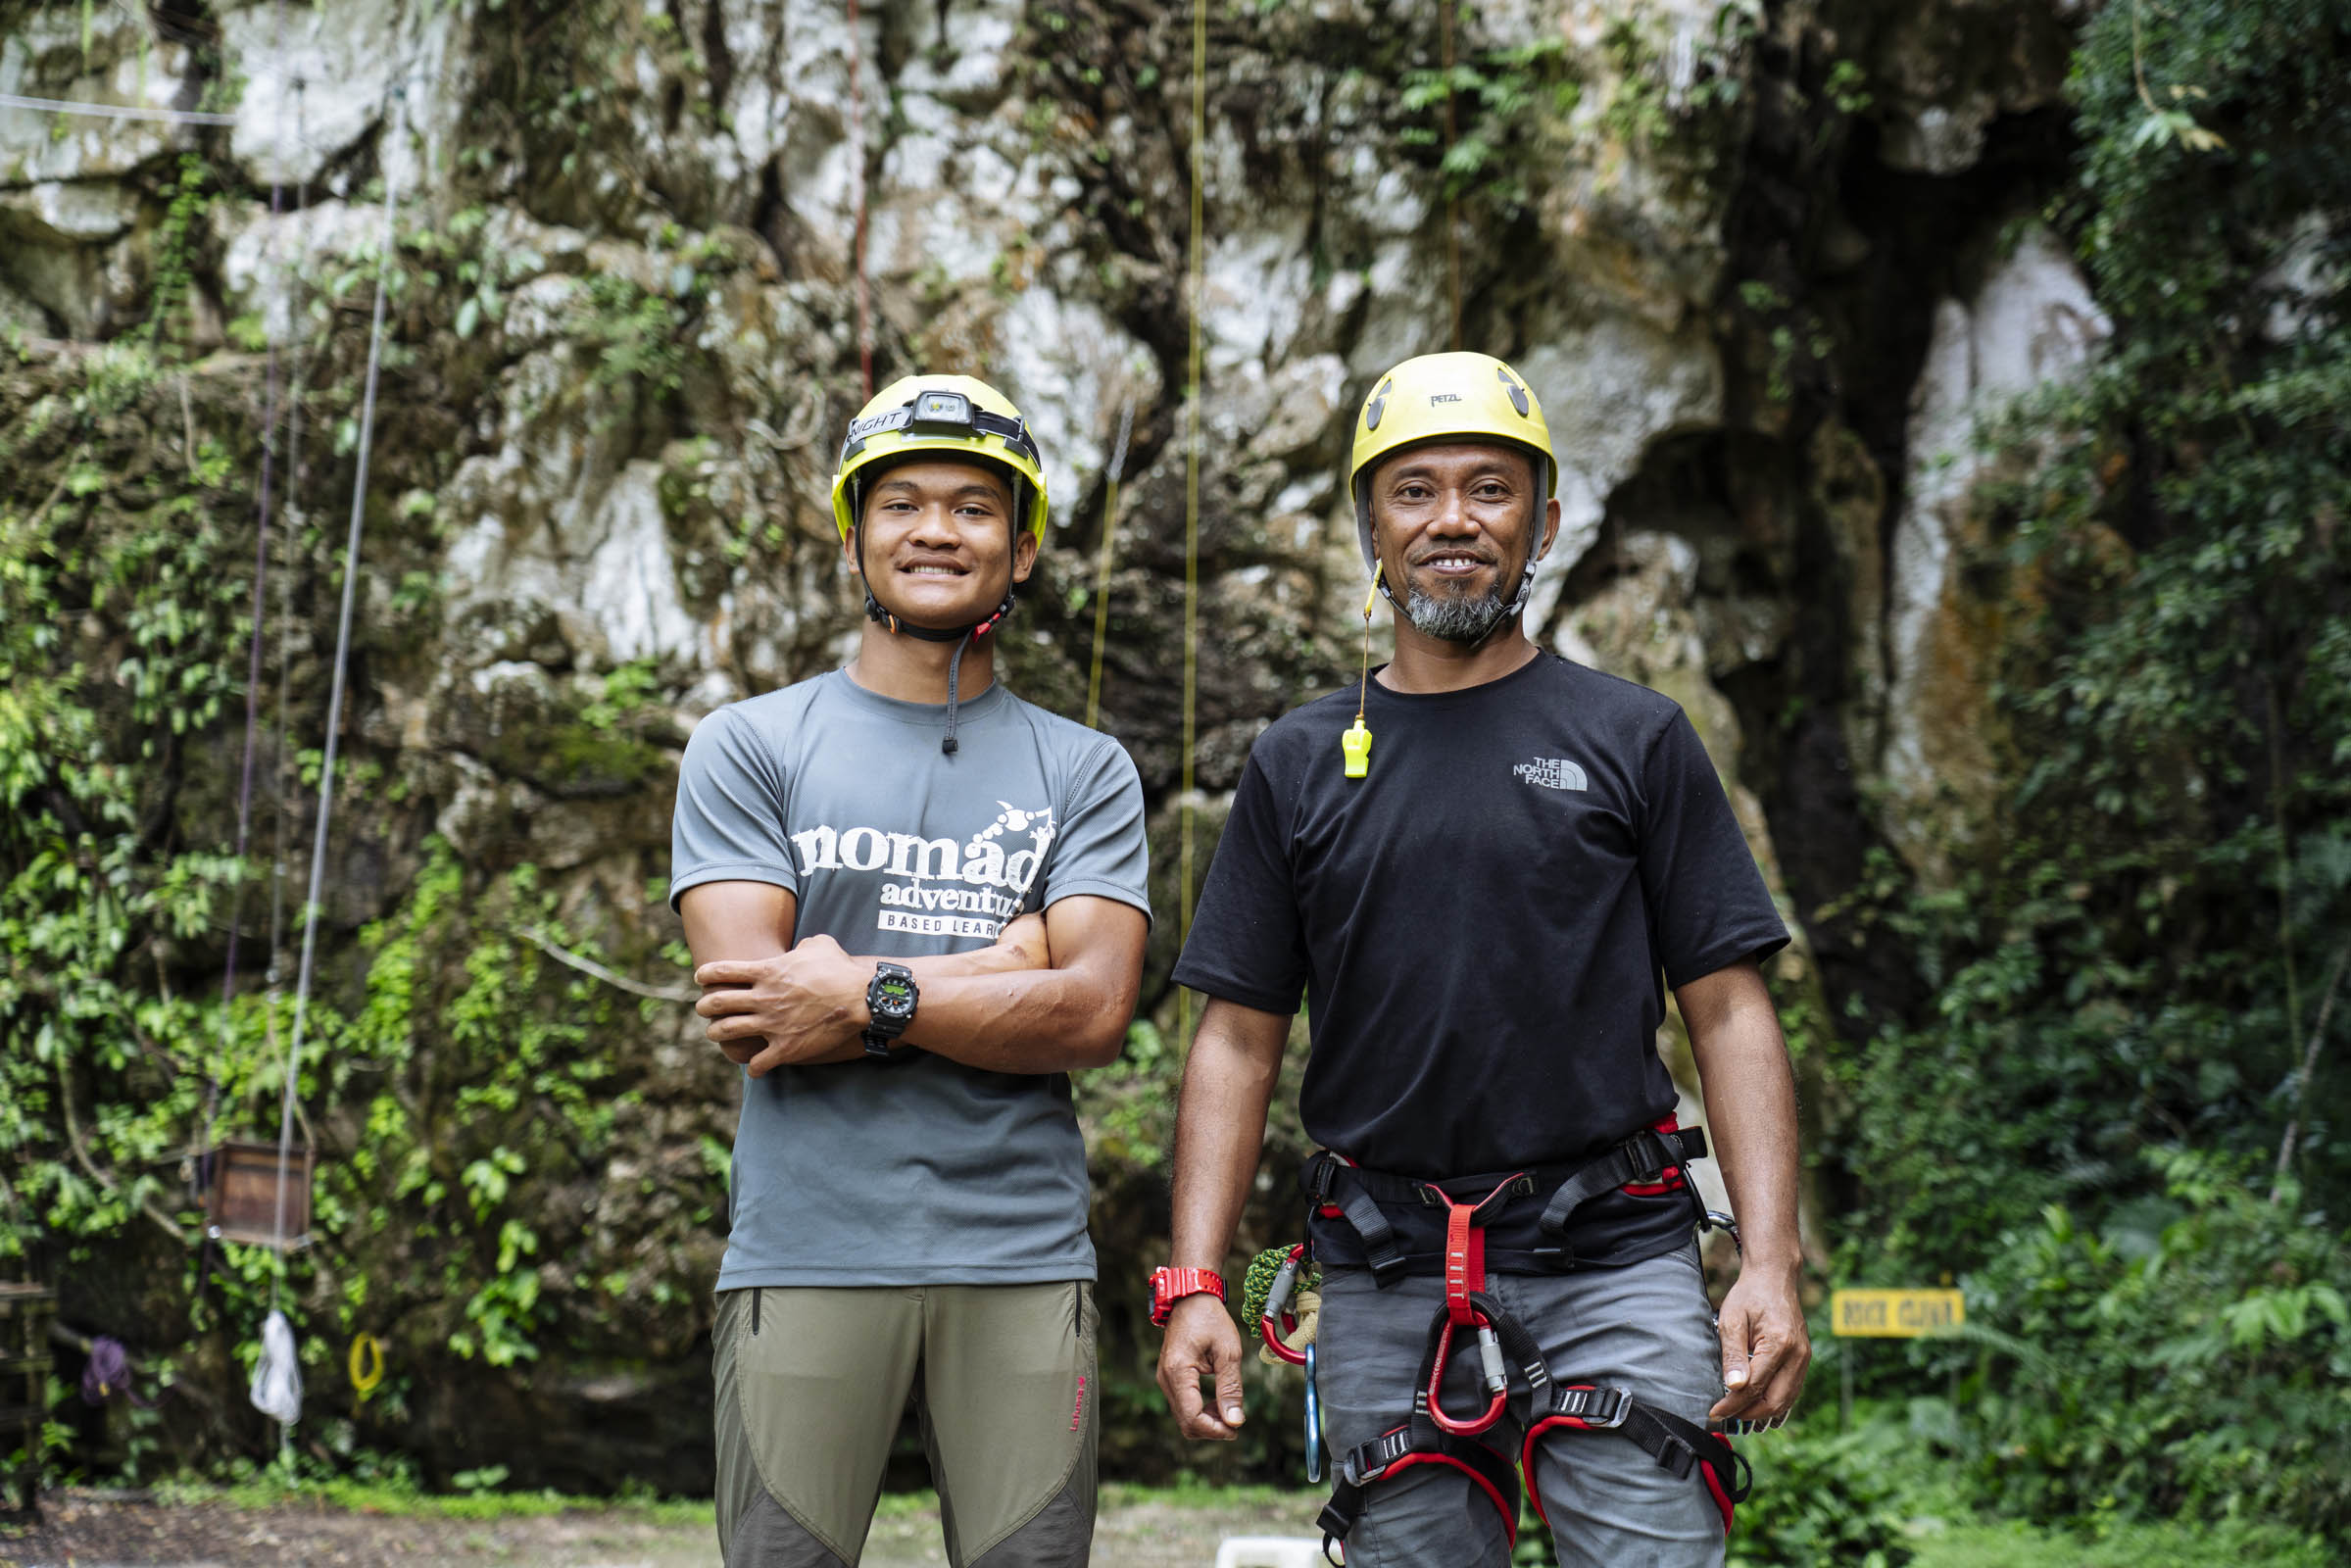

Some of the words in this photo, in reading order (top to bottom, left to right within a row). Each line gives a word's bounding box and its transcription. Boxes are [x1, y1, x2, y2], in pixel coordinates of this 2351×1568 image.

[1430, 393, 1463, 408] PETZL
[1513, 763, 1560, 779] NORTH
[1534, 757, 1561, 769] THE
[1525, 773, 1560, 790] FACE
[790, 823, 1053, 894] nomad
[887, 914, 942, 932] BASED
